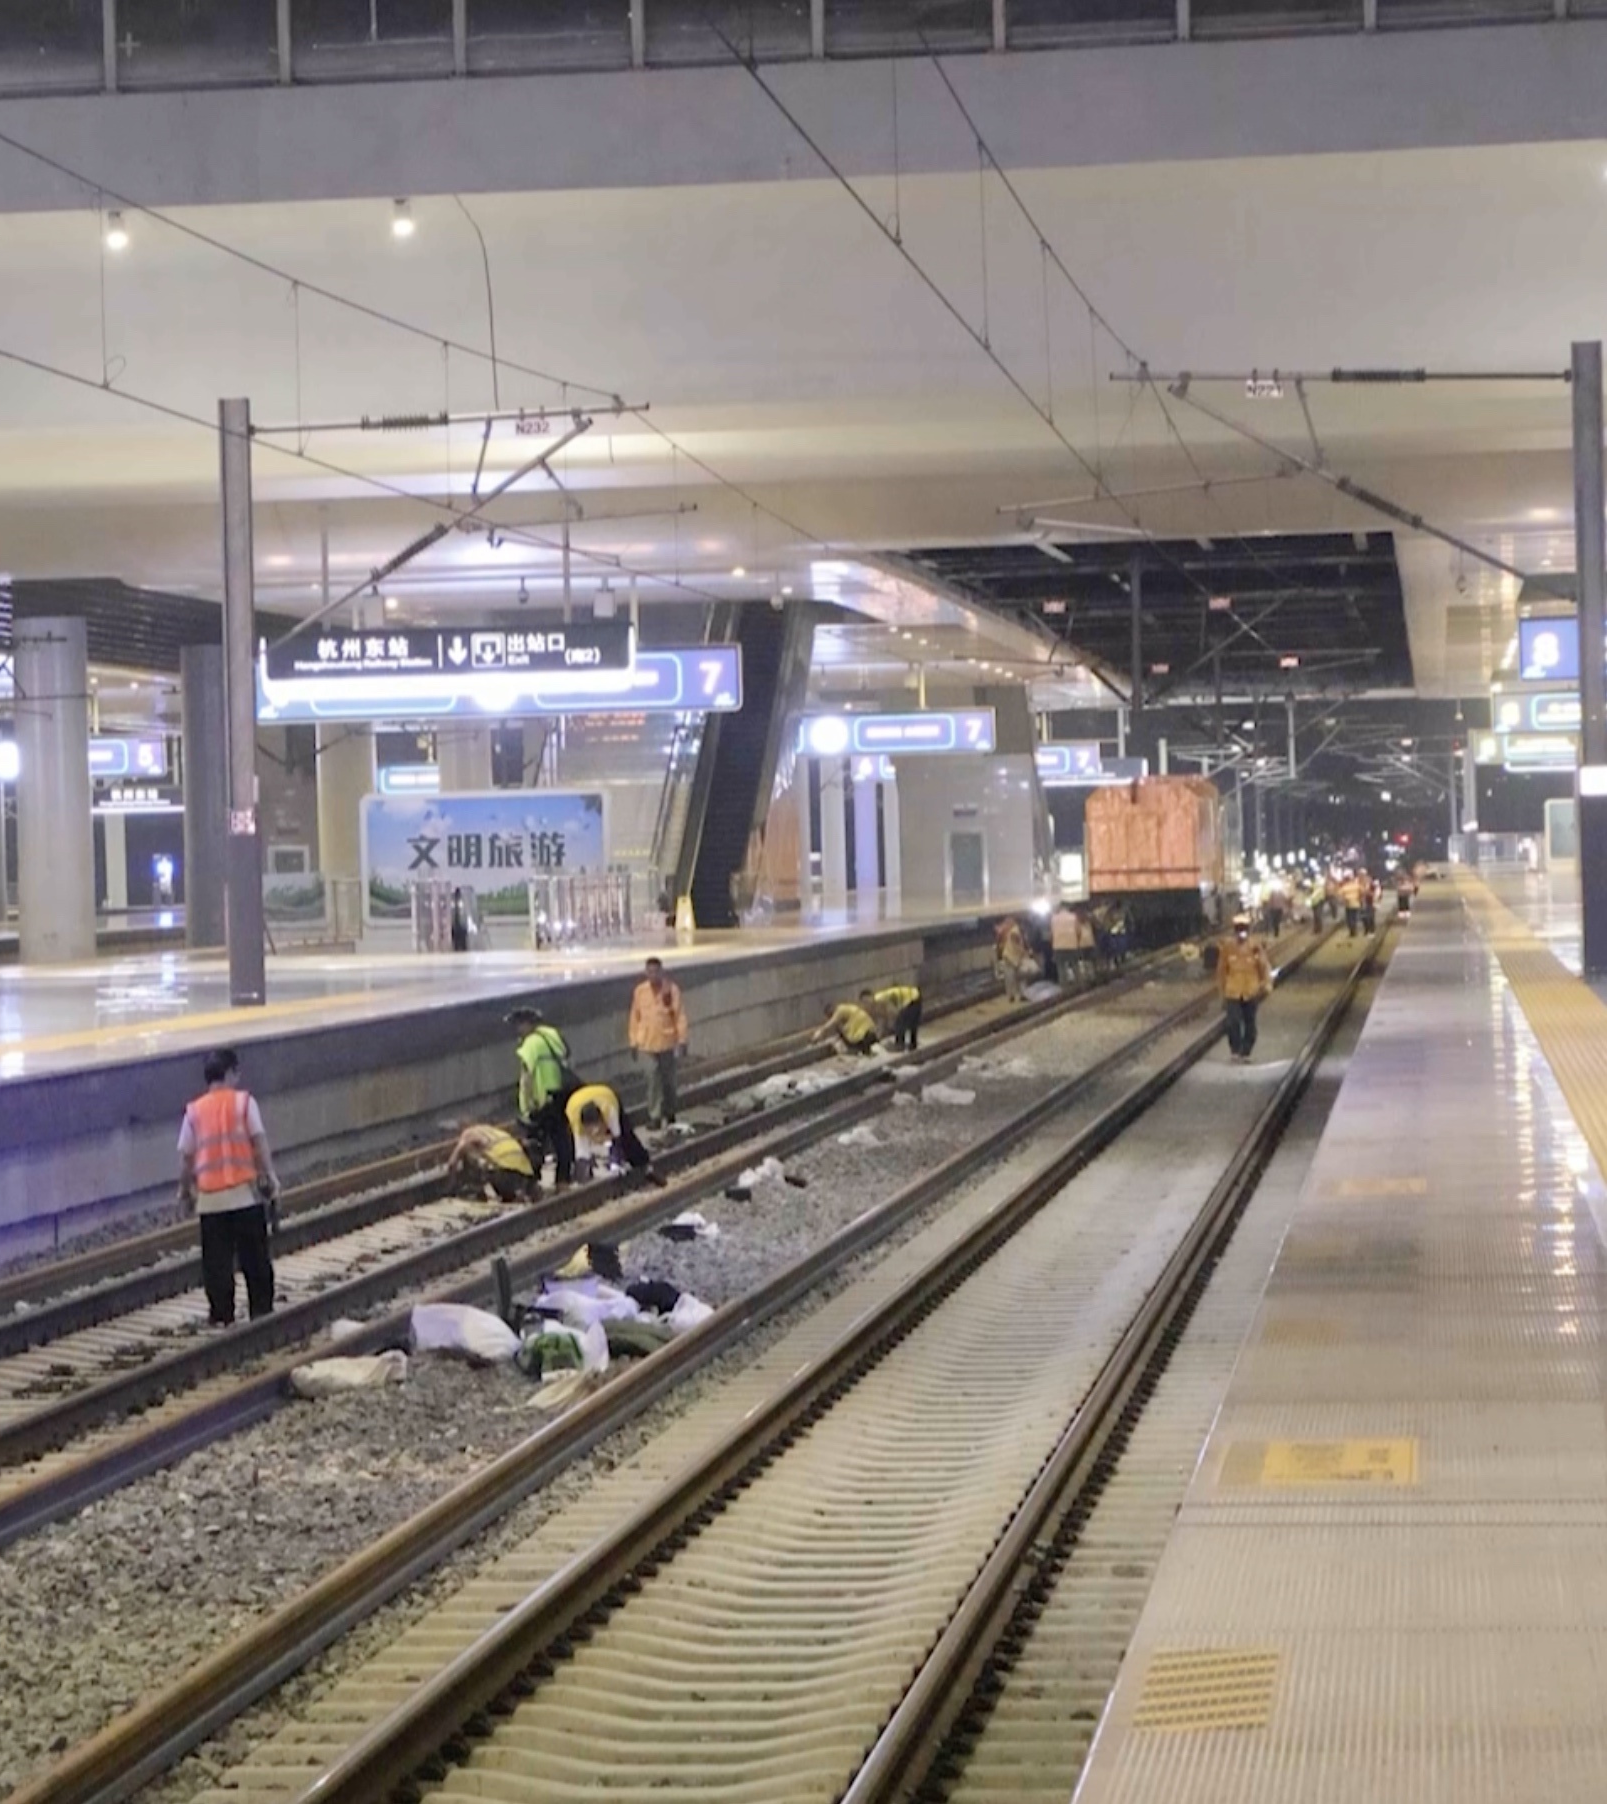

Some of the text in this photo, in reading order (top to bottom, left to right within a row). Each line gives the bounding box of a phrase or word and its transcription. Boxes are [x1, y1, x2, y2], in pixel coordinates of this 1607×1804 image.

[317, 636, 409, 660] 杭州东站
[507, 633, 565, 653] 出站口
[698, 660, 723, 694] 7
[965, 719, 984, 743] 7
[406, 831, 566, 870] 文明旅游
